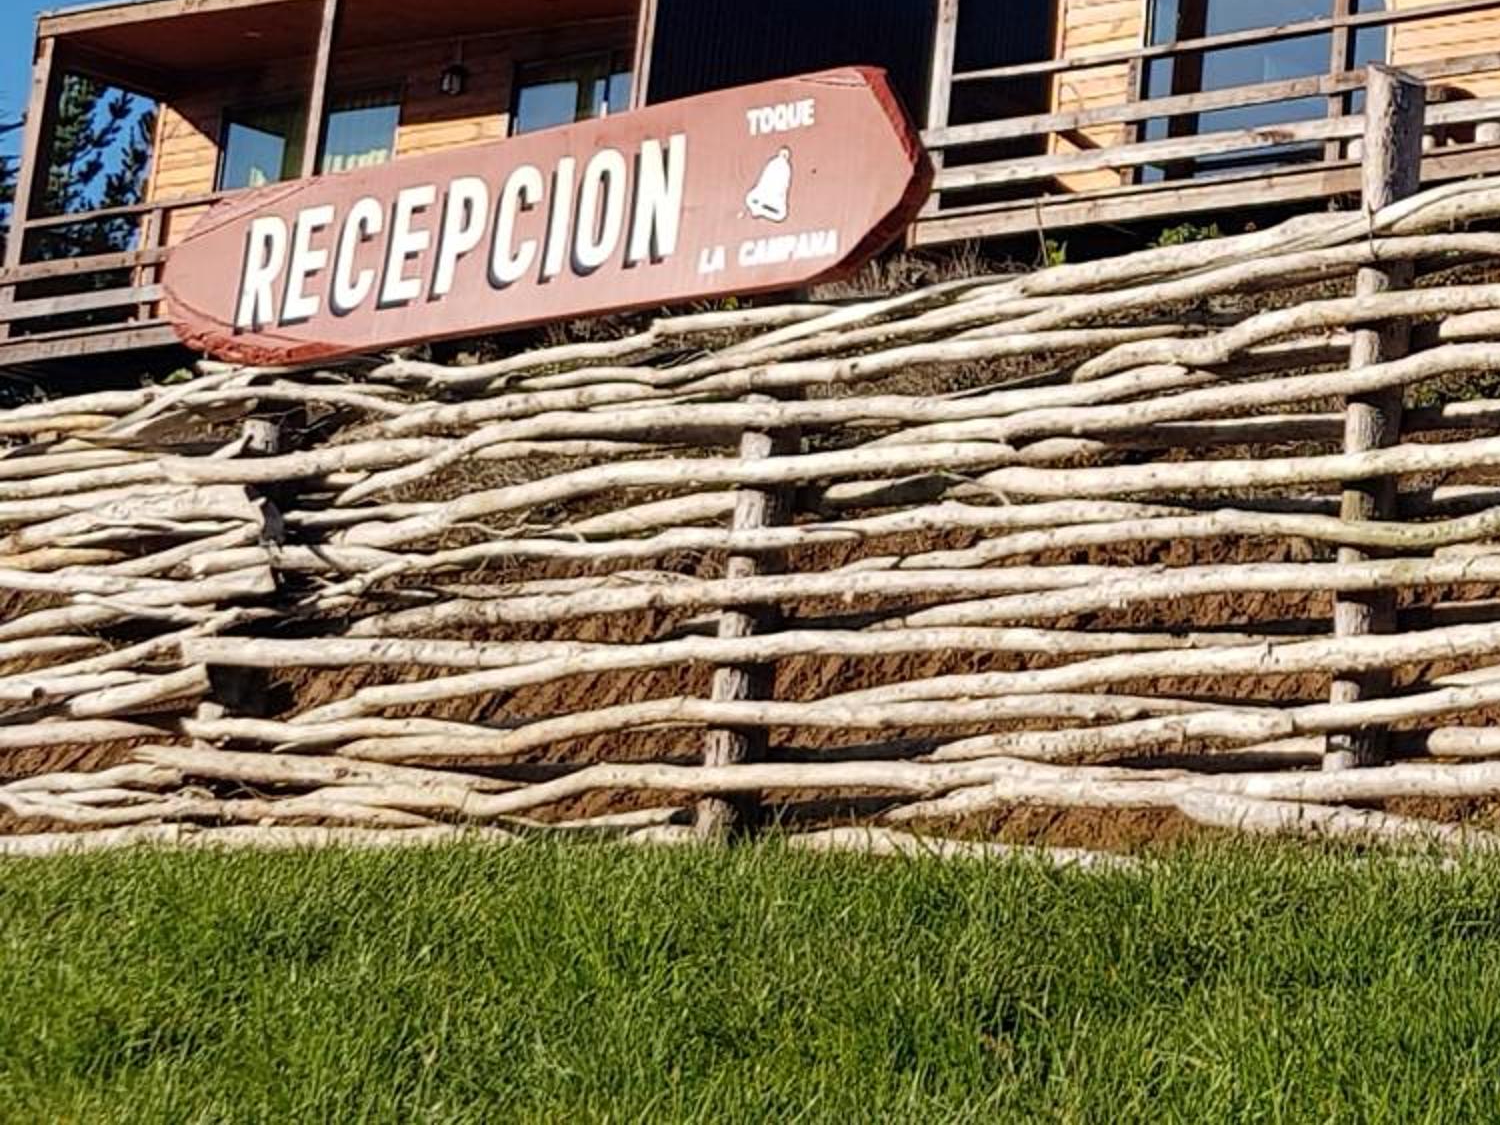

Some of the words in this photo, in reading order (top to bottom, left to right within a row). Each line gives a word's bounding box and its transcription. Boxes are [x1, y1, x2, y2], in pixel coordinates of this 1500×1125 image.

[746, 99, 816, 136] TOQUE
[235, 133, 687, 331] RECEPCION
[697, 246, 727, 275] LA
[738, 229, 838, 268] CAMPANA
